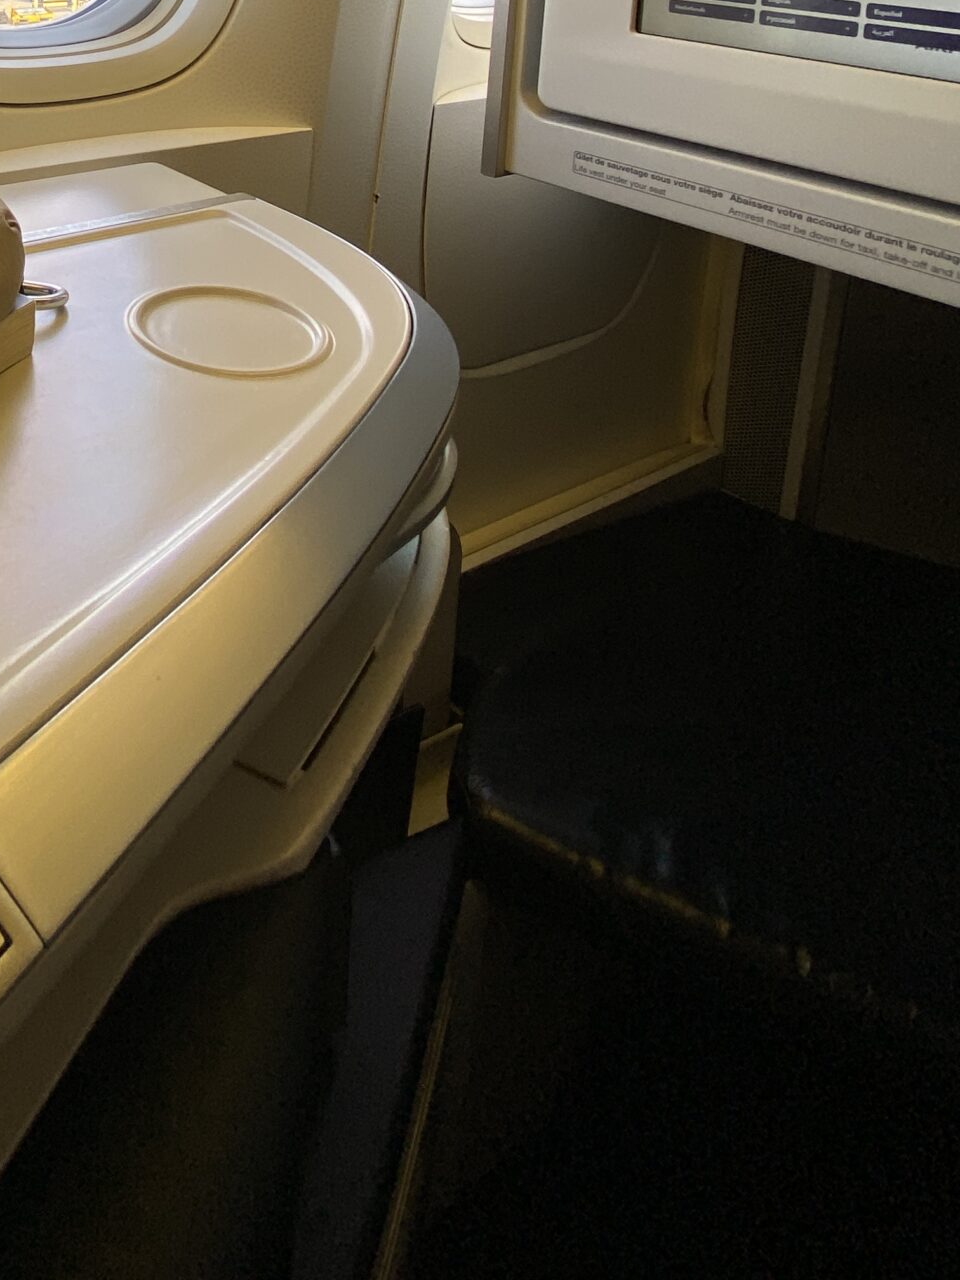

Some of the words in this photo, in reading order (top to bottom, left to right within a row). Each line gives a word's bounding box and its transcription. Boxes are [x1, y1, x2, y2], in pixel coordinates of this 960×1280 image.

[575, 152, 594, 164] Gilet
[595, 157, 605, 167] de
[607, 161, 649, 179] sauvetage
[650, 173, 672, 185] sous
[673, 180, 697, 192] votre
[698, 185, 724, 199] siège
[606, 173, 628, 186] under
[630, 180, 647, 192] your
[728, 207, 765, 223] Armrest
[766, 218, 791, 231] must
[793, 226, 807, 237] be
[809, 231, 838, 245] down
[840, 238, 855, 250] for
[883, 251, 929, 269] take-off
[930, 264, 954, 278] and
[729, 194, 775, 213] Abaissez
[777, 207, 803, 221] votre
[806, 216, 861, 236] accoudoir
[864, 231, 904, 248] durant
[907, 240, 918, 251] le
[920, 247, 960, 266] roulag
